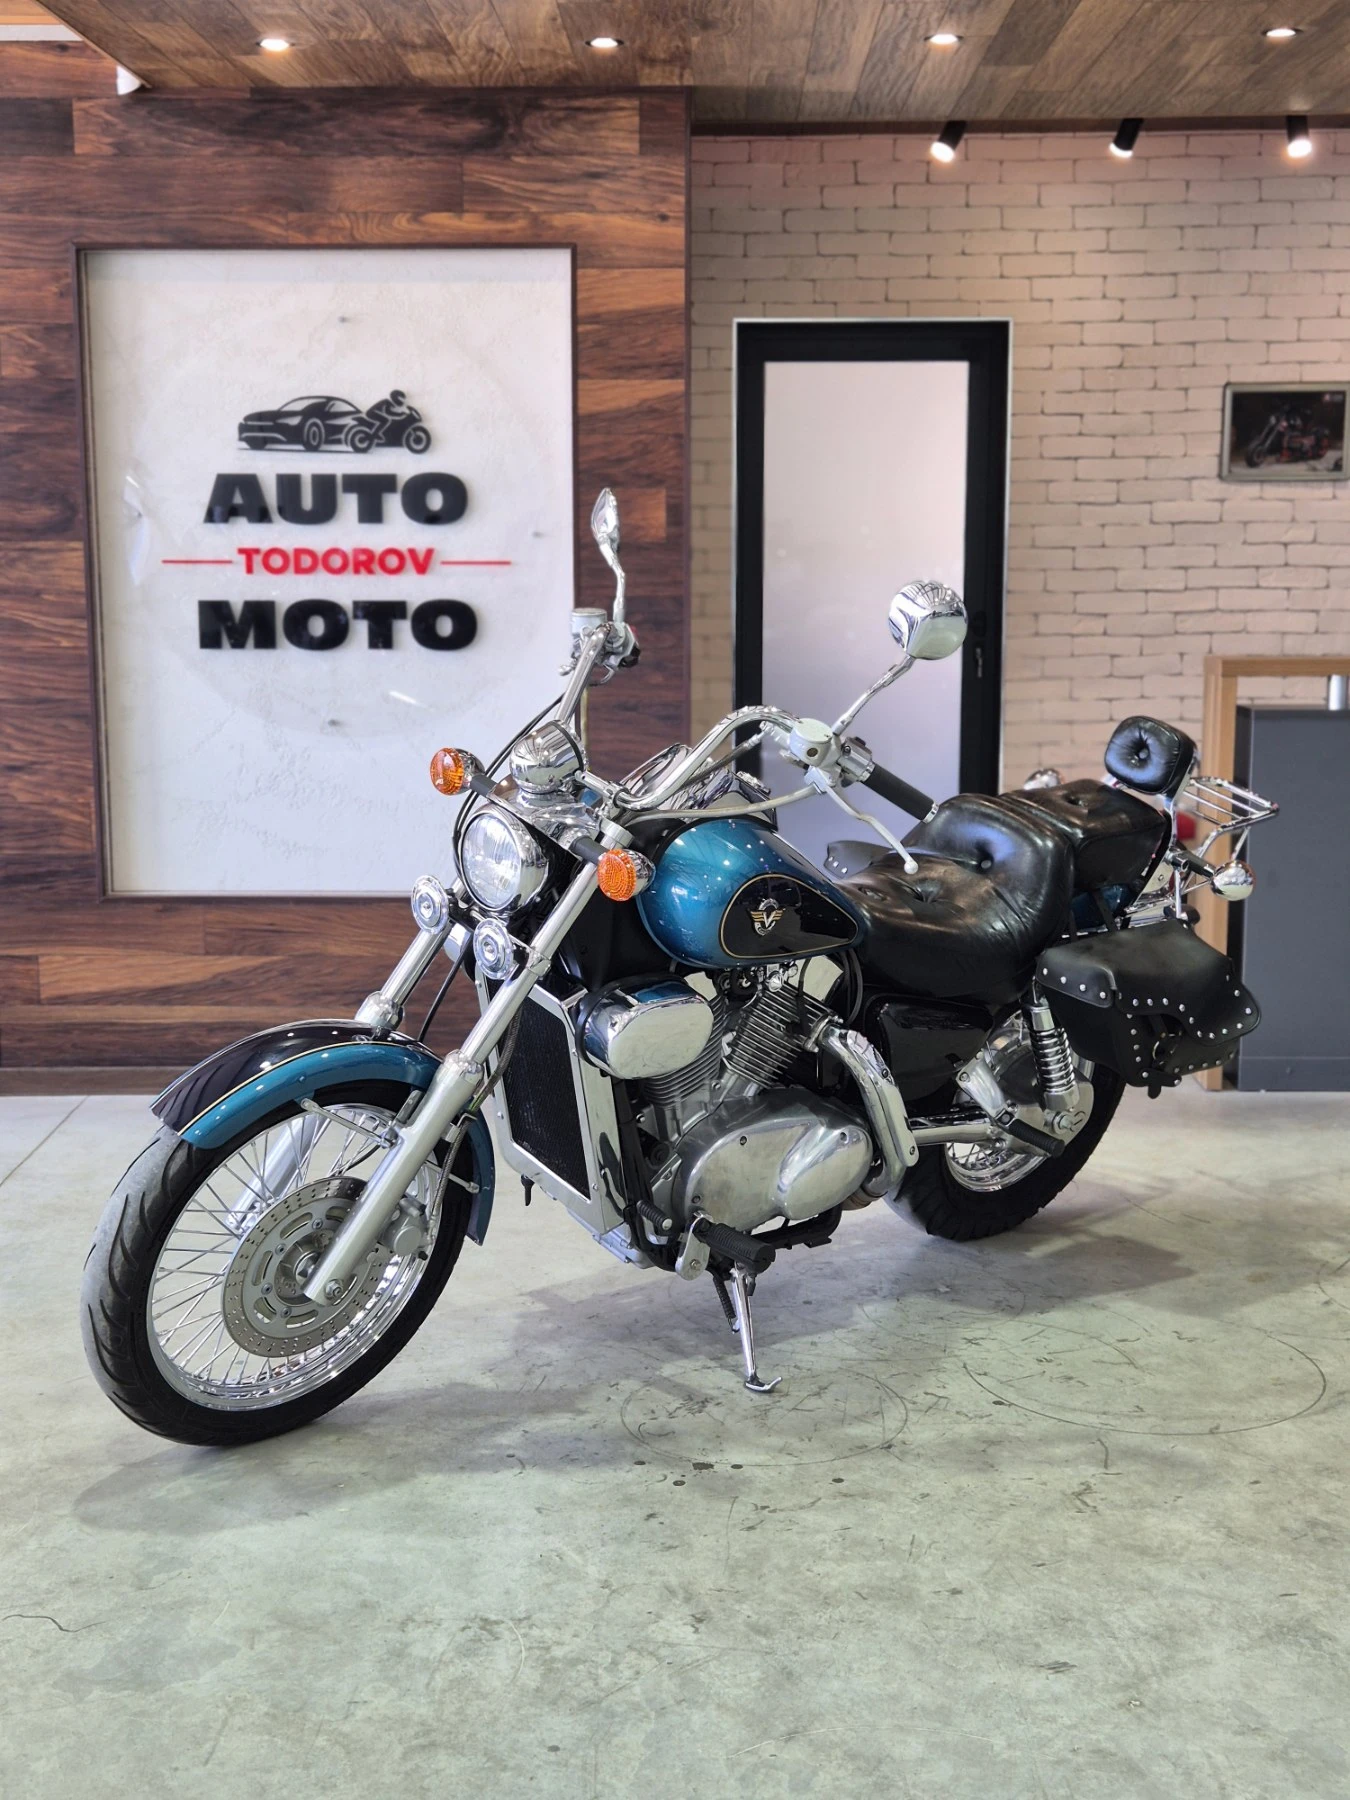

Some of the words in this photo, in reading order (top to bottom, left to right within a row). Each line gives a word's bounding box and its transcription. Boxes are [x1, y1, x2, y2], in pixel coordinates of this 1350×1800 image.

[203, 472, 468, 526] AUTO
[237, 547, 435, 576] TODOROV
[198, 599, 478, 652] MOTO
